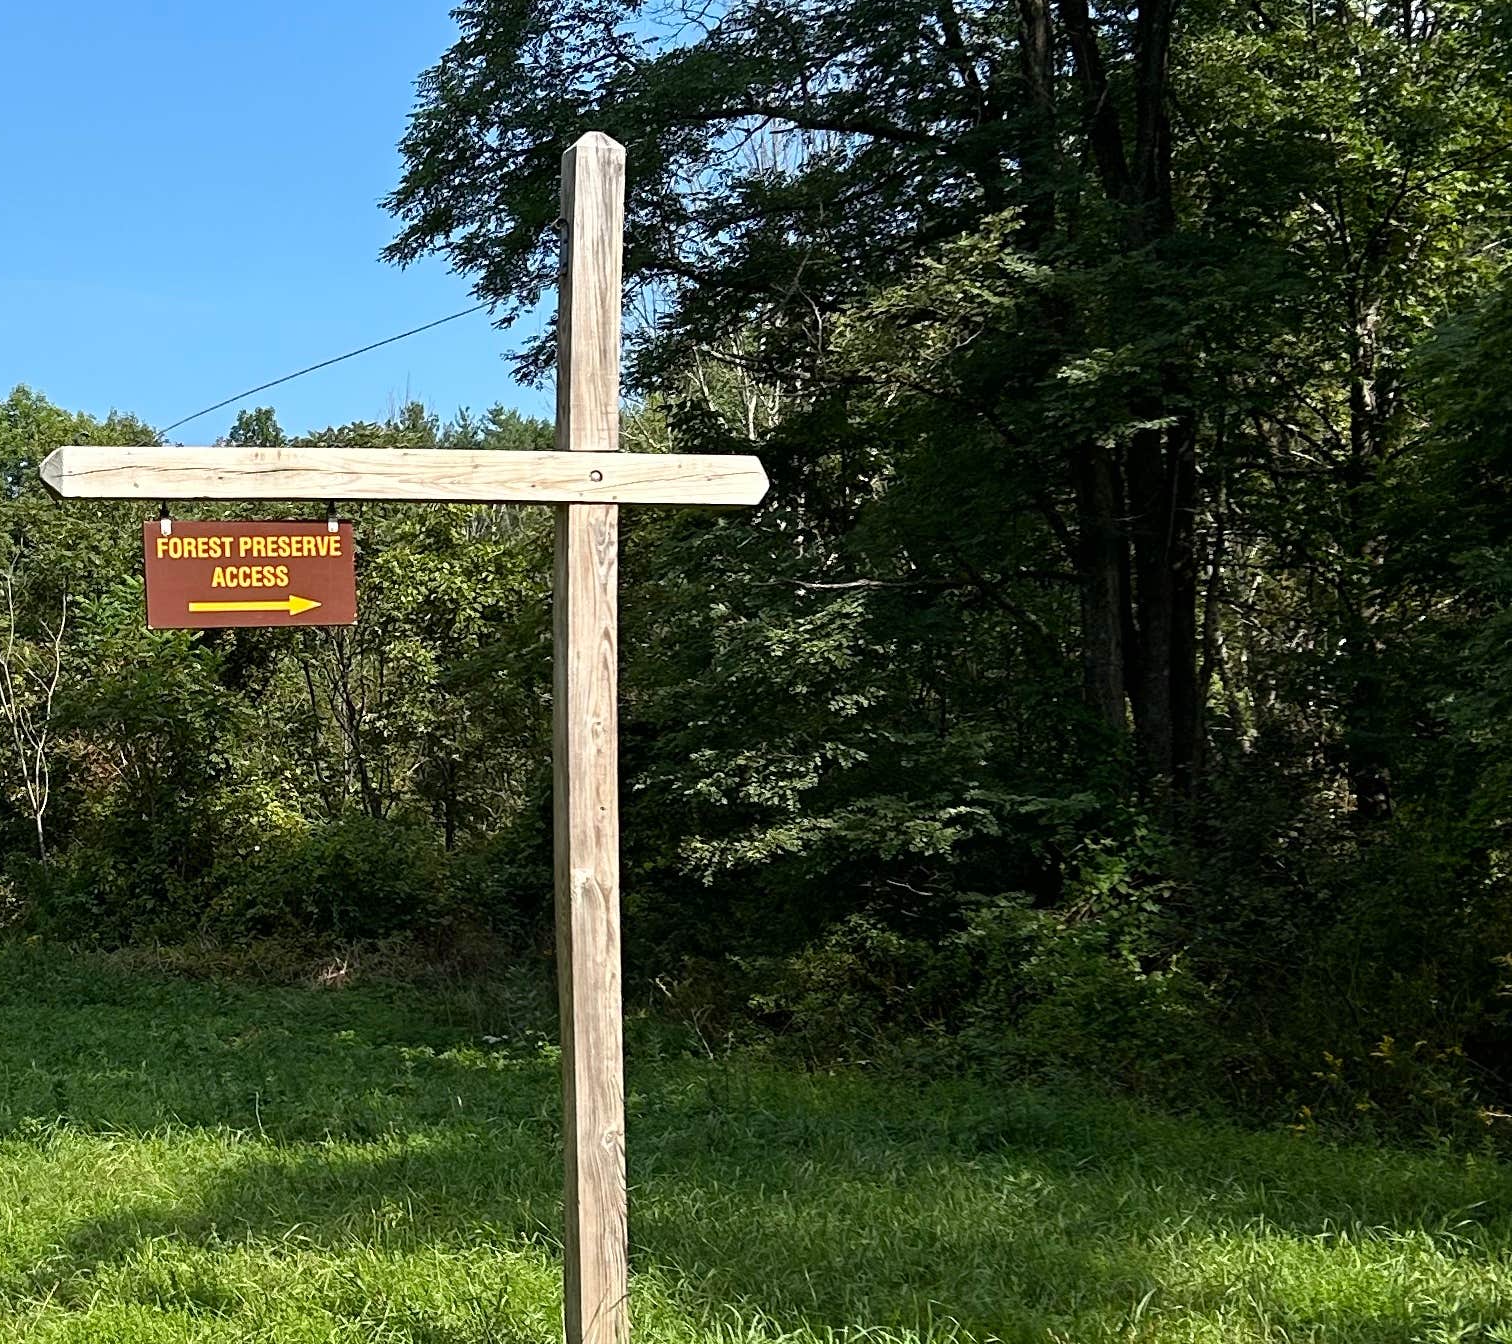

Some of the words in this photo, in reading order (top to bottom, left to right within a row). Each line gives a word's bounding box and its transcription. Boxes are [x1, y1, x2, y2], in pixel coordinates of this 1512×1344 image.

[157, 537, 234, 558] FOREST
[239, 535, 342, 557] PRESERVE
[211, 565, 289, 588] ACCESS
